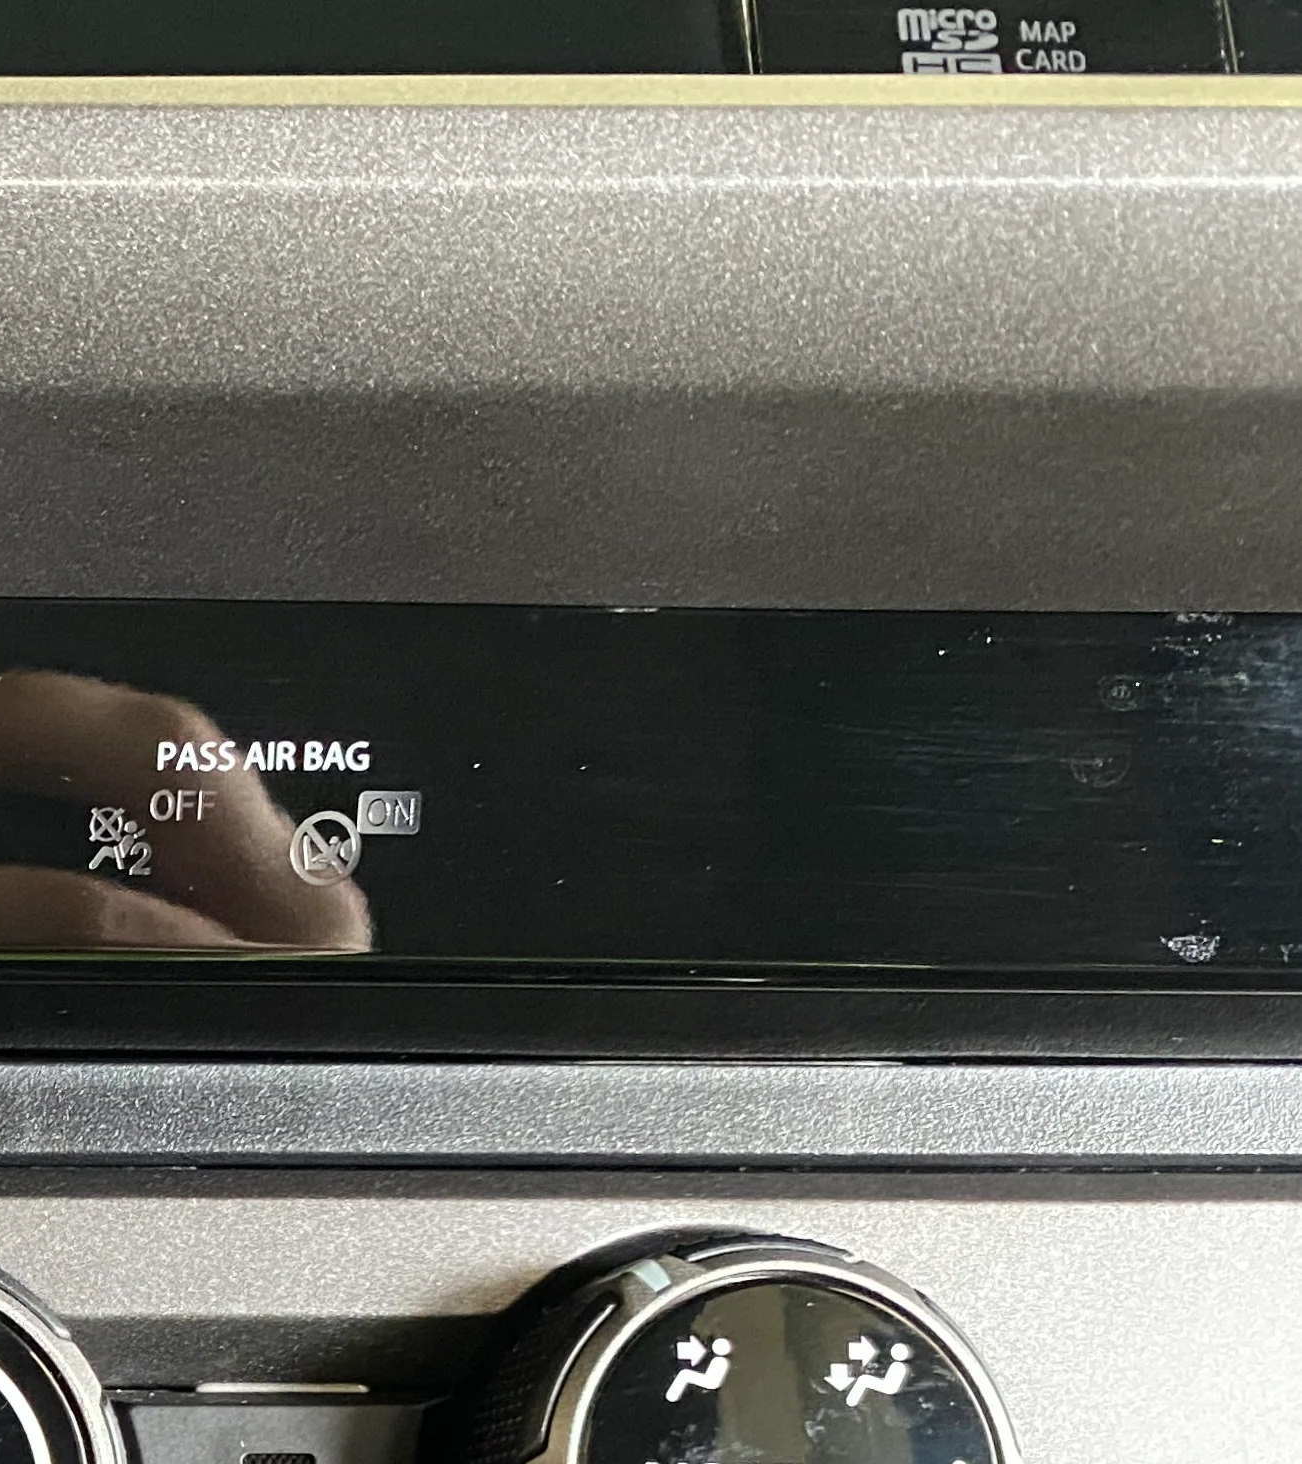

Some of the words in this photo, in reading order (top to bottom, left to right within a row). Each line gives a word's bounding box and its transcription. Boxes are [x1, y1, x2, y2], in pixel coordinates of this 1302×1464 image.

[1019, 20, 1076, 43] MAP
[1014, 48, 1087, 73] CARD
[156, 740, 236, 772] PASS
[242, 740, 297, 772] AIR
[302, 740, 372, 772] BAG
[148, 789, 219, 822] OFF
[366, 798, 417, 827] ON
